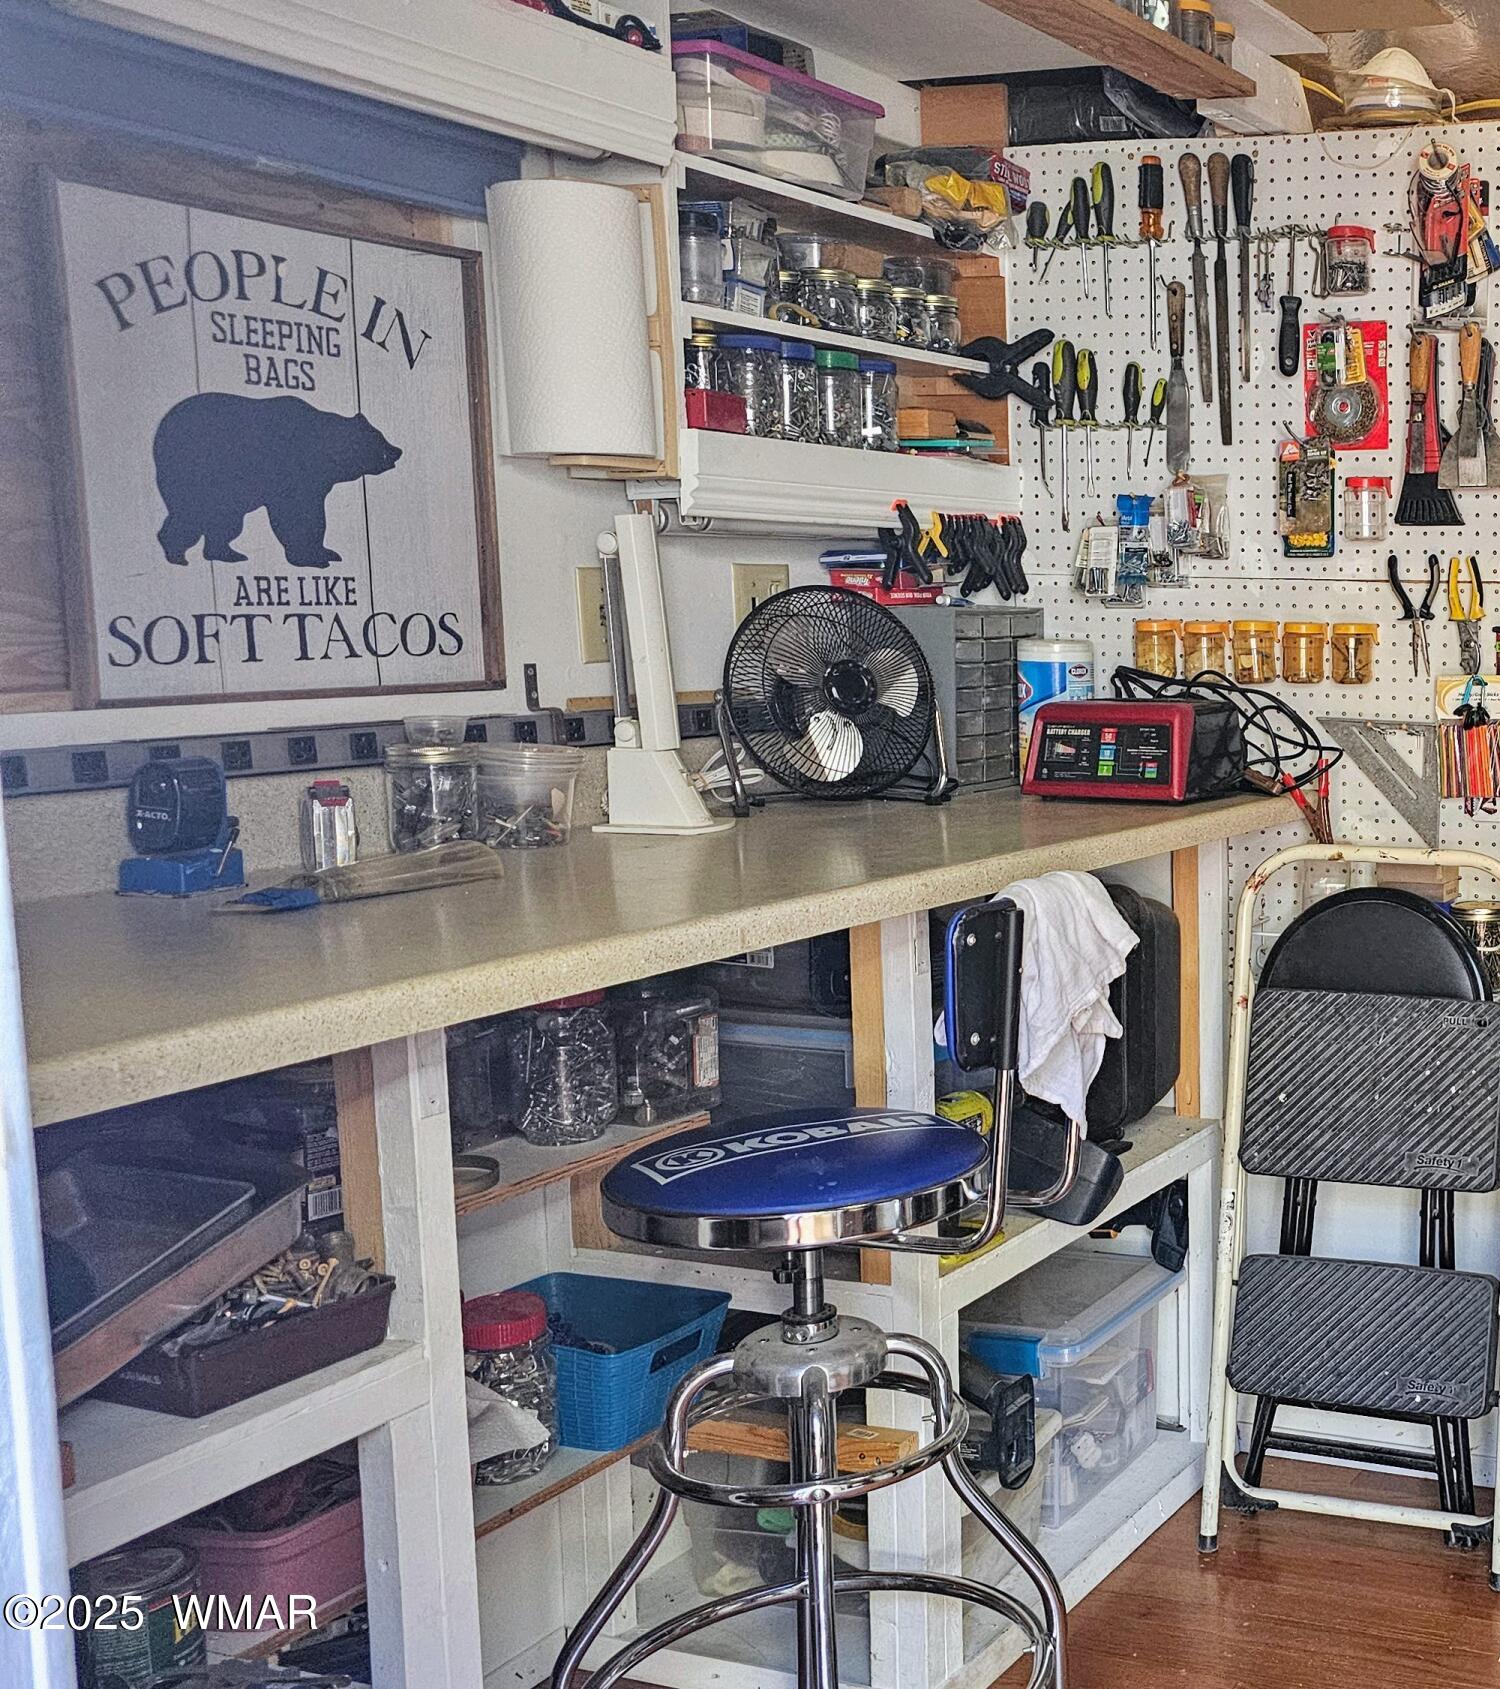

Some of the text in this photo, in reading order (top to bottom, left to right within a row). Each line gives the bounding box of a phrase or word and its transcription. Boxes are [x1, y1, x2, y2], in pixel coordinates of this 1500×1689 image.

[95, 250, 433, 370] PEOPLE IN
[211, 311, 342, 357] SLEEPING
[243, 354, 317, 391] BAGS
[233, 576, 358, 607] ARE LIKE
[108, 612, 464, 667] SOFT TACOS
[1046, 728, 1091, 737] BATTERY CHARGER
[1443, 1017, 1467, 1026] PULL
[724, 1113, 936, 1153] KOBALT
[1417, 1154, 1455, 1169] Safety
[1408, 1380, 1447, 1395] Safety
